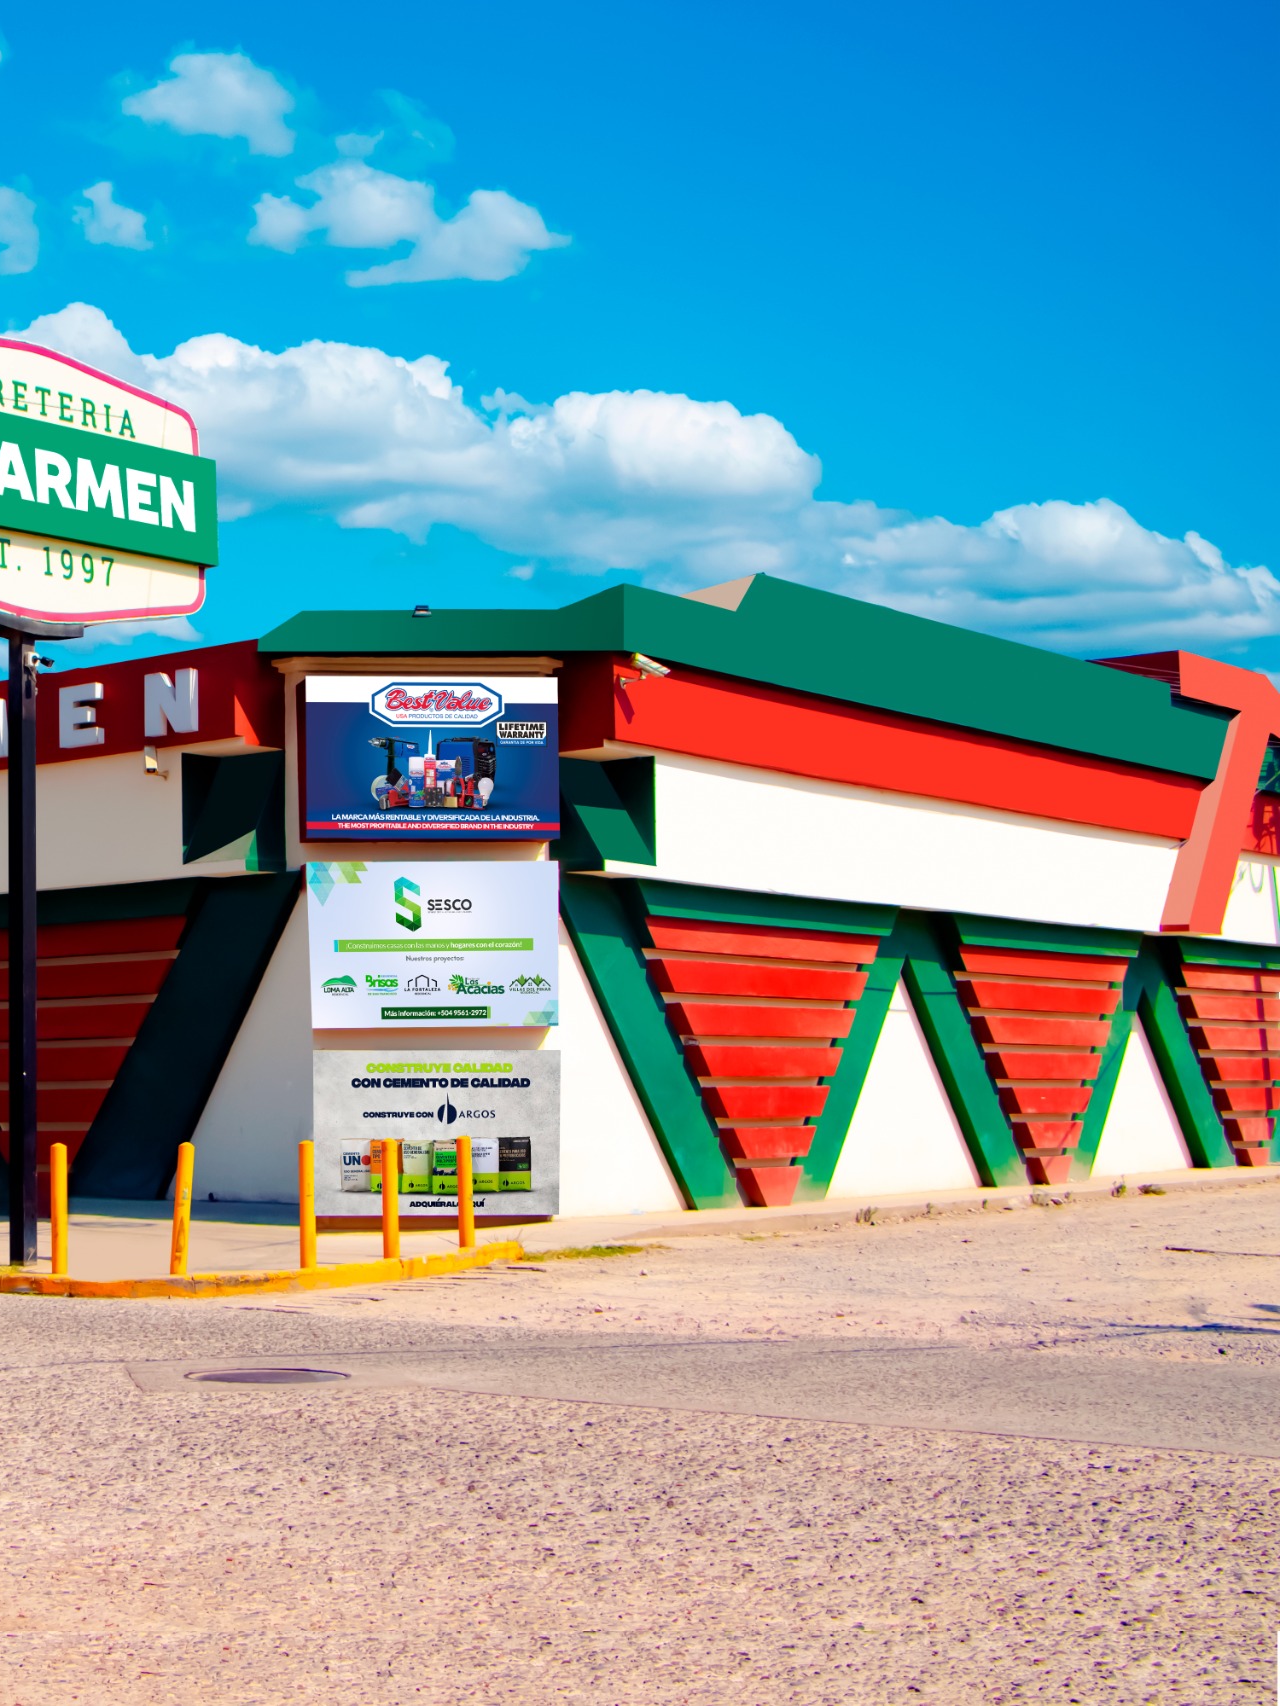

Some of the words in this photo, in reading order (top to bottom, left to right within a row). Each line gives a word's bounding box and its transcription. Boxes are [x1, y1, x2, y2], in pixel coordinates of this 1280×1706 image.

[43, 546, 114, 587] 1997
[385, 688, 435, 711] Best
[434, 689, 492, 712] Value
[498, 723, 545, 731] LIFETIME
[498, 731, 545, 739] WARRANTY
[331, 813, 342, 821] LA
[342, 813, 368, 821] MARCA
[368, 812, 385, 821] MÁS
[385, 813, 421, 821] RENTABLE
[427, 898, 472, 911] SESCO
[365, 975, 399, 988] Brisas
[465, 977, 479, 985] Los
[456, 983, 505, 995] Acacias
[398, 1009, 436, 1017] información:
[366, 1062, 451, 1073] CONSTRUYE
[453, 1062, 513, 1073] CALIDAD
[351, 1077, 382, 1088] CON
[382, 1077, 449, 1088] CEMENTO
[450, 1077, 469, 1088] DE
[470, 1077, 531, 1088] CALIDAD
[362, 1111, 414, 1119] CONSTRUYE
[415, 1111, 434, 1119] CON
[458, 1110, 496, 1118] ARGOS
